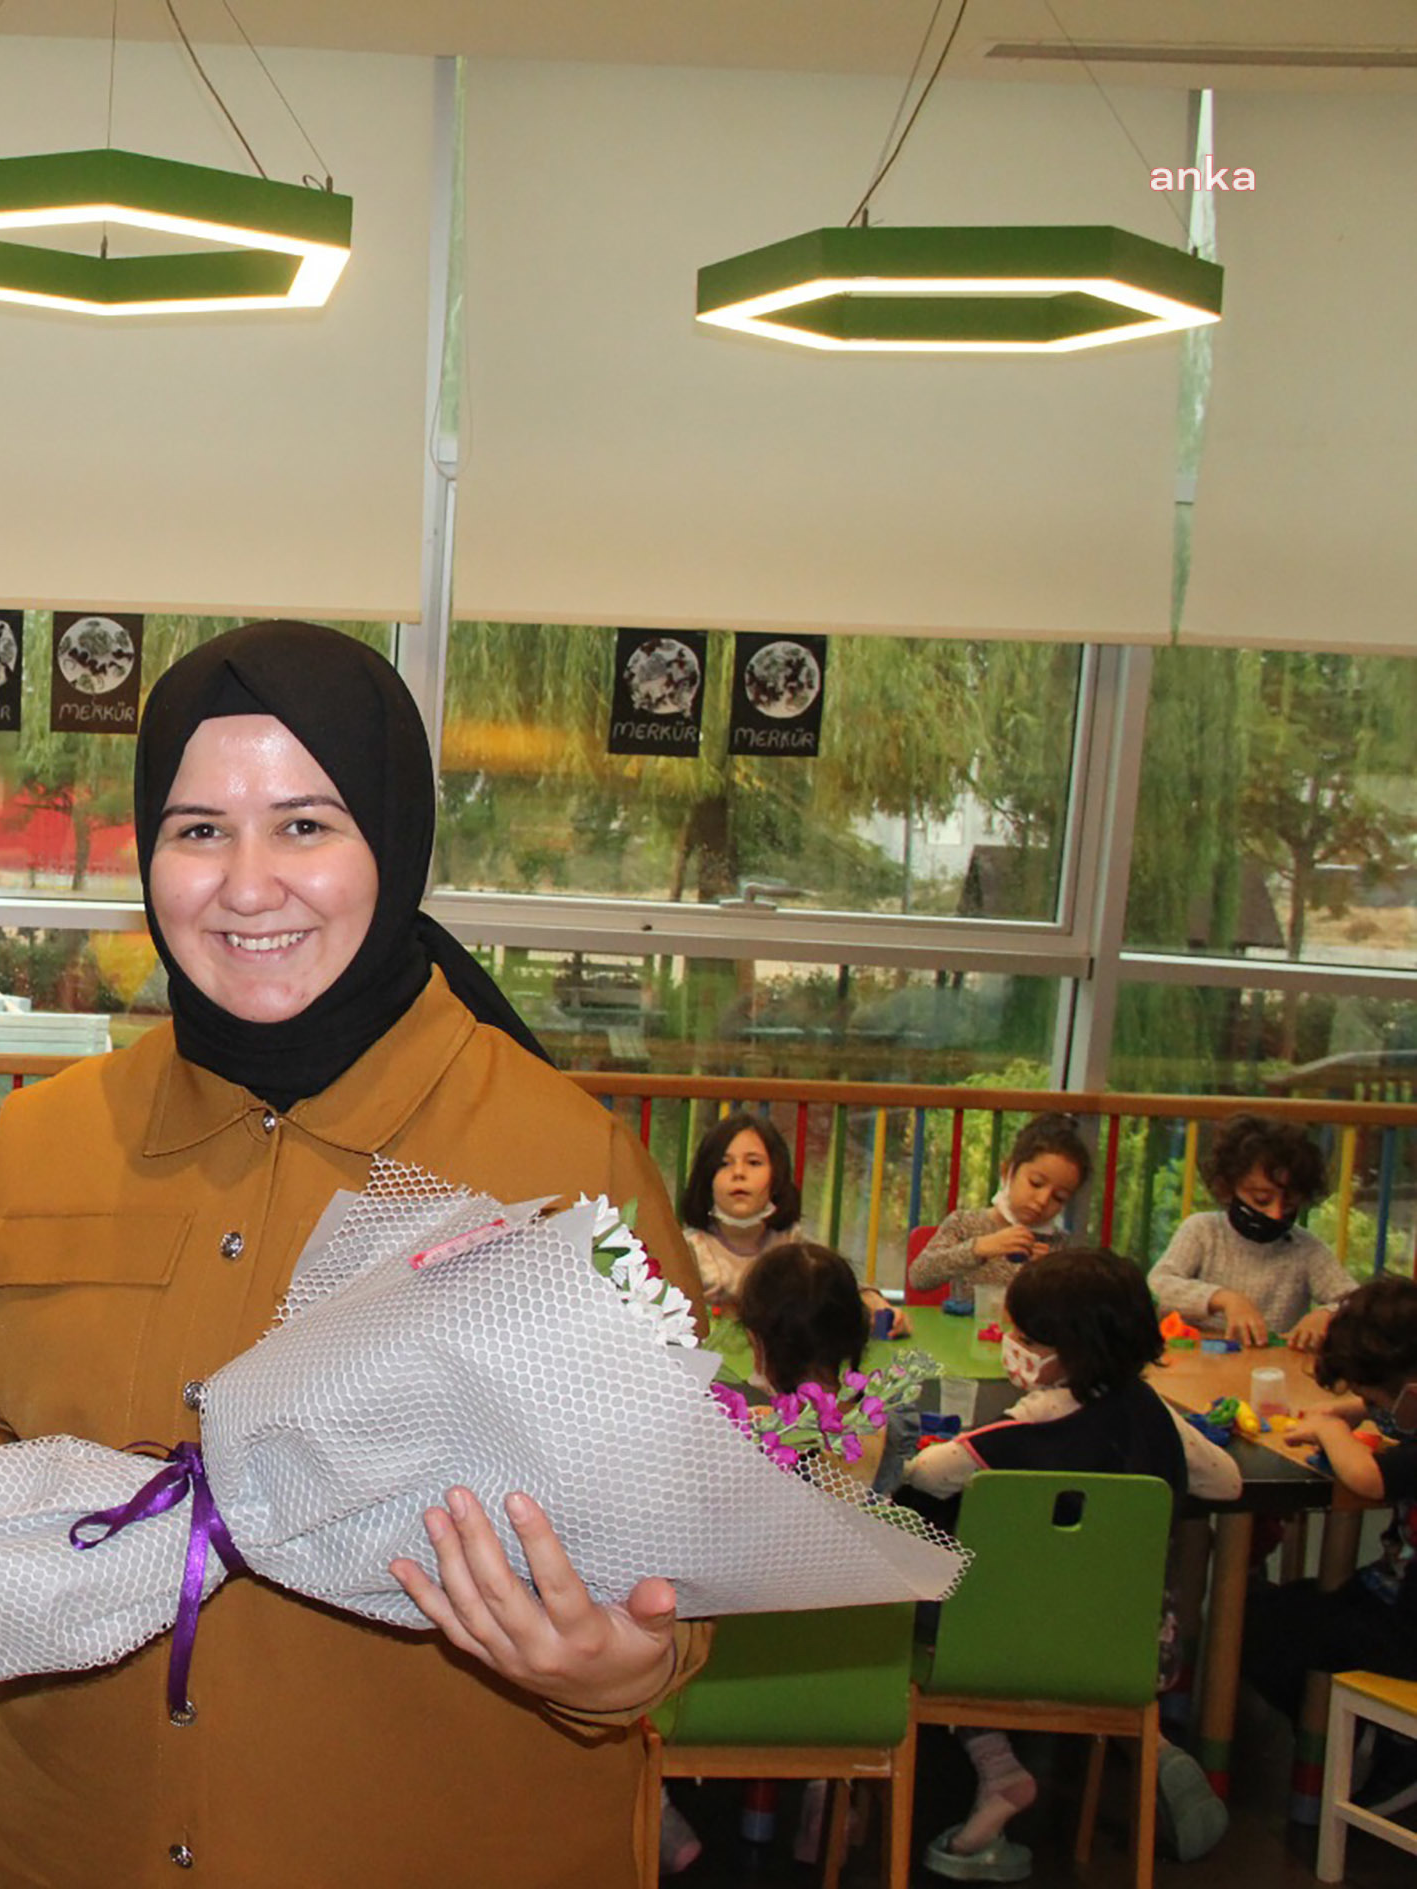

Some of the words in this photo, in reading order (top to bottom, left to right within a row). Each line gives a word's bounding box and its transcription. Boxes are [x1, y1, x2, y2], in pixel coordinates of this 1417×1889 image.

[58, 701, 135, 722] MERKÜR
[612, 721, 698, 741] MERKÜR
[734, 728, 815, 748] MERKÜR
